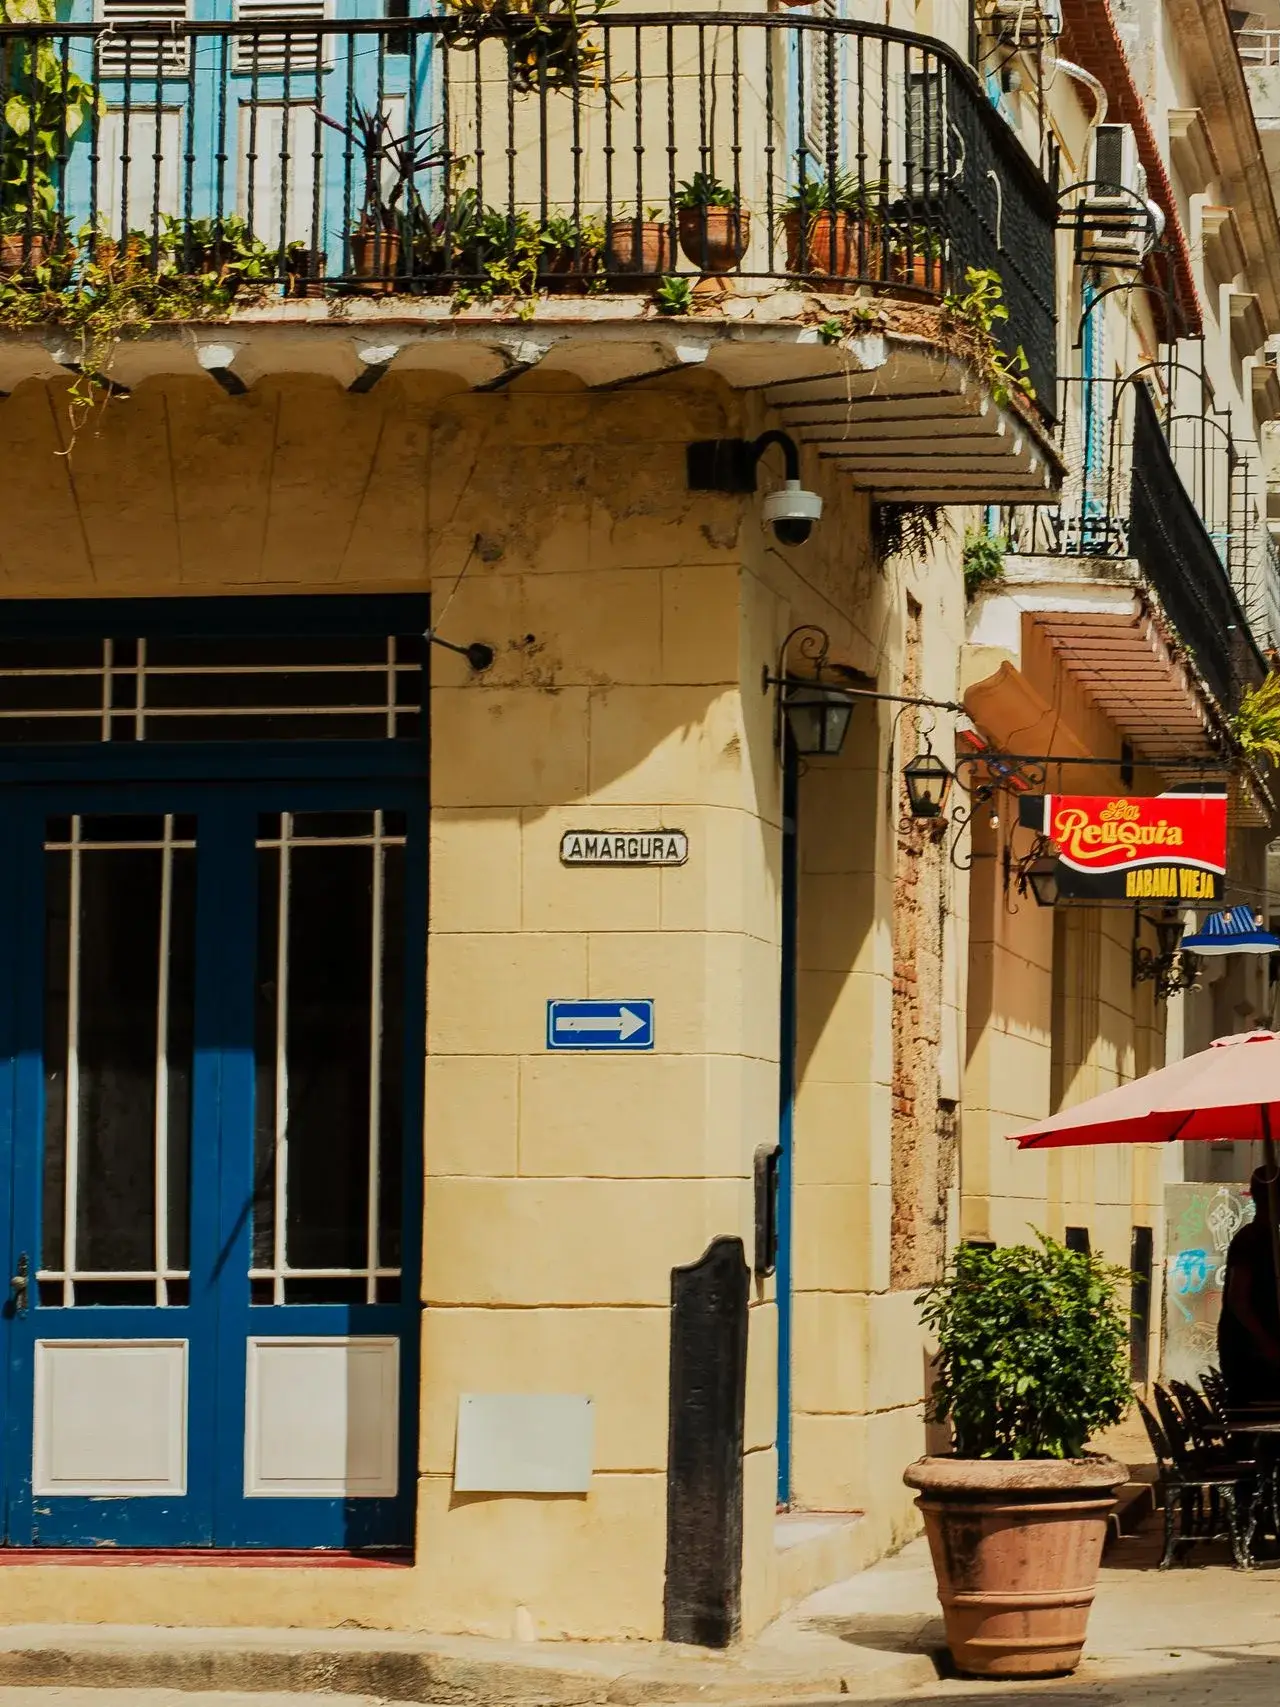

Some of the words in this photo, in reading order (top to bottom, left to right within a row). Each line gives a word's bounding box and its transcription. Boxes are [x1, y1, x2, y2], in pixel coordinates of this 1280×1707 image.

[1100, 799, 1140, 821] La
[569, 837, 678, 858] AMARGURA
[1126, 869, 1177, 897] HABANA
[1180, 868, 1214, 898] VIEJA
